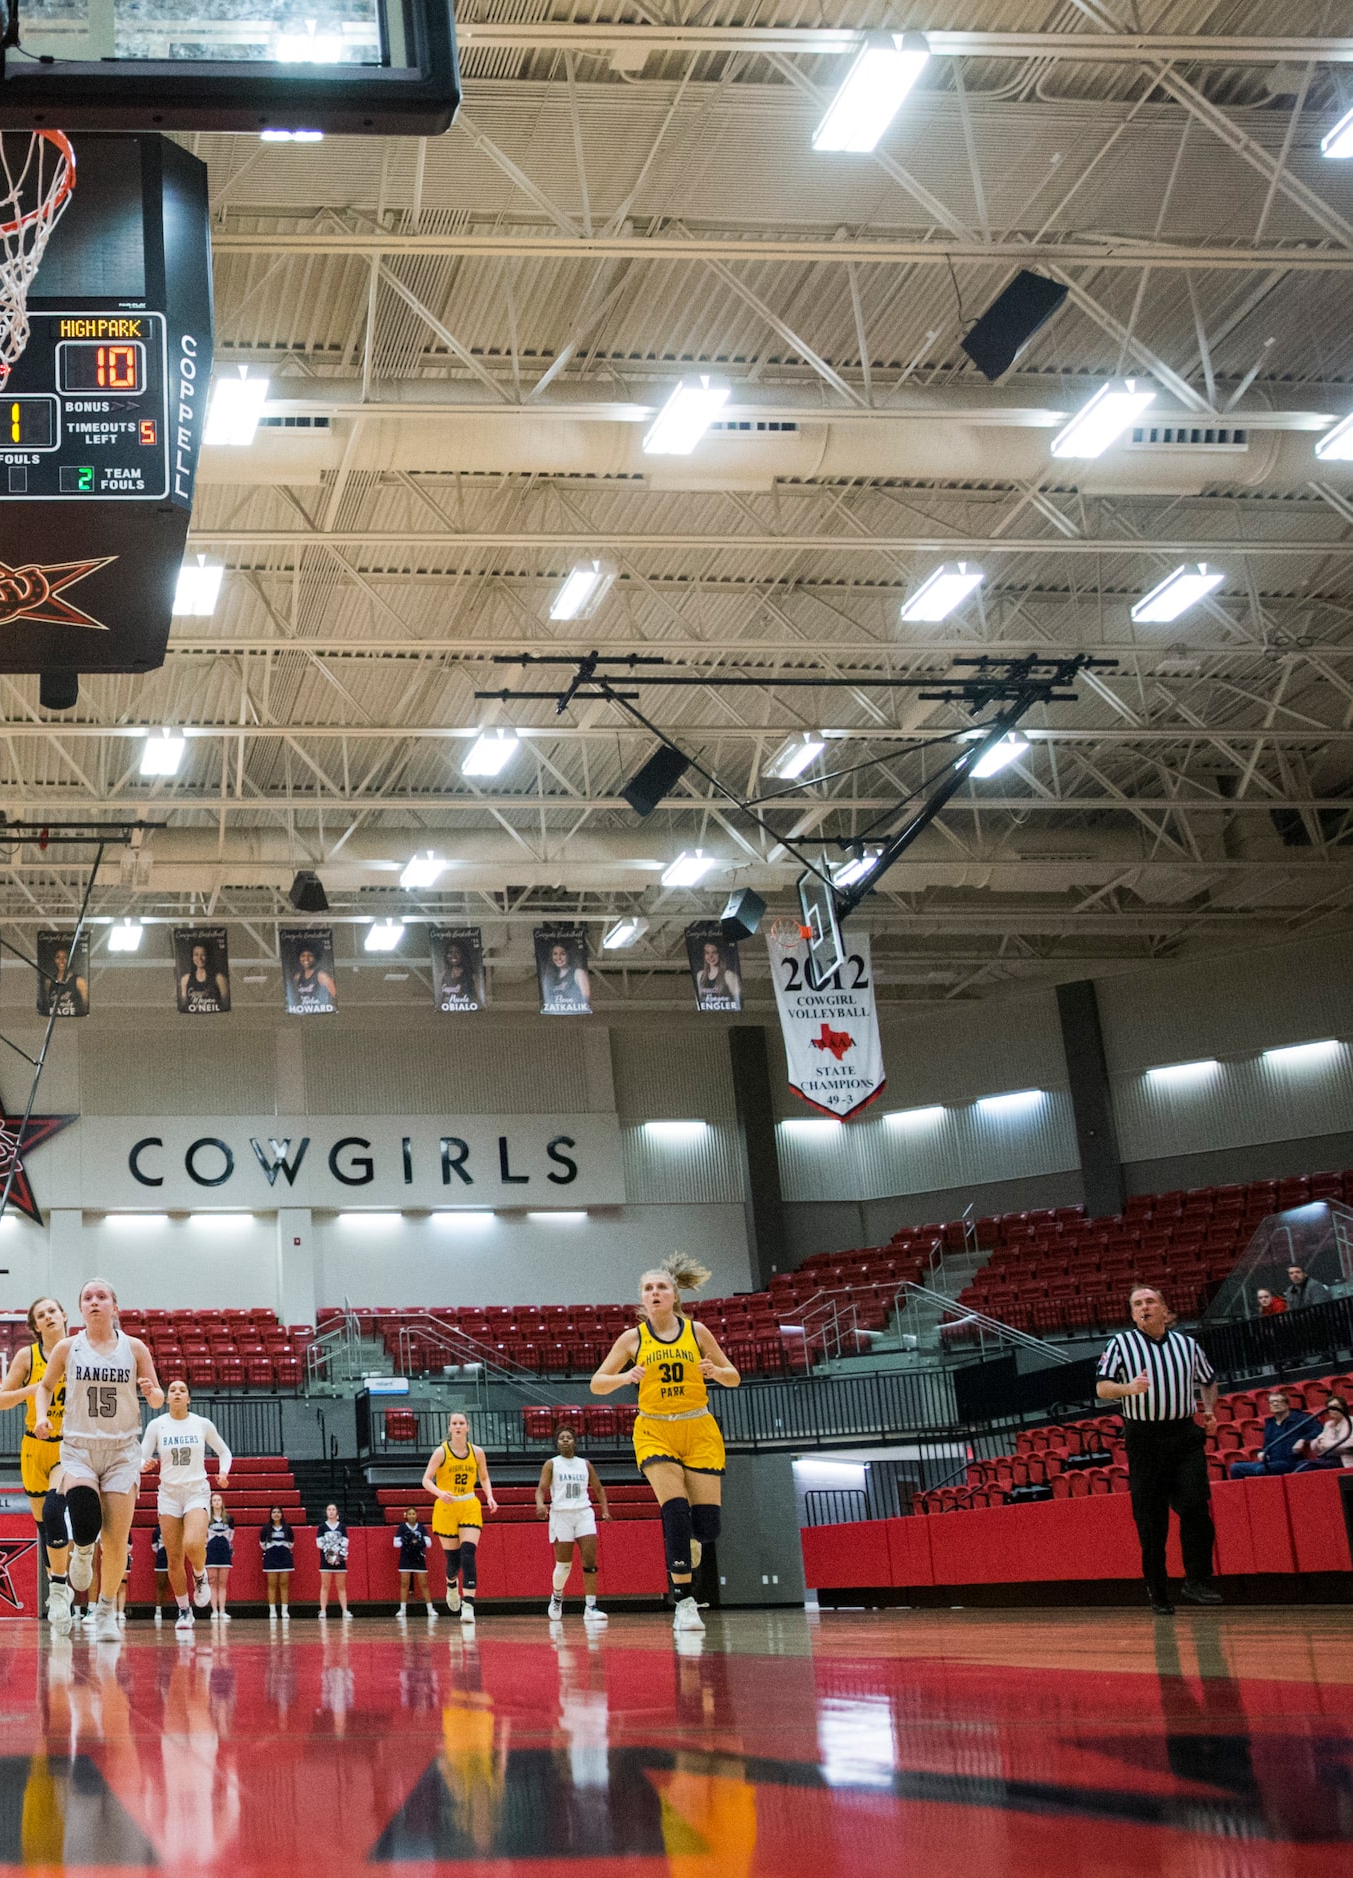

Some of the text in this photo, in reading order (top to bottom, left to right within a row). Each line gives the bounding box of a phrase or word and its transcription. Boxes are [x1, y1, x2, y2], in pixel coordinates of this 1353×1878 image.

[96, 346, 135, 387] 10
[65, 401, 110, 413] BONUS
[174, 334, 198, 500] COPPELL
[67, 422, 137, 433] TIMEOUTS
[140, 421, 155, 443] 5
[85, 434, 118, 445] LEFT
[78, 467, 92, 490] 2
[104, 468, 142, 479] TEAM
[100, 479, 145, 490] FOULS
[700, 1001, 738, 1010] ENGLER
[797, 995, 857, 1006] COWGIRL
[188, 1004, 221, 1012] O'NEIL
[288, 1004, 334, 1014] HOWARD
[441, 1003, 478, 1012] OBIALO
[543, 1002, 588, 1012] ZATKALIK
[788, 1007, 871, 1020] VOLLEYBALL
[815, 1065, 857, 1077] STATE
[800, 1078, 875, 1090] CHAMPIONS
[128, 1136, 579, 1188] COWGIRLS
[646, 1347, 695, 1366] HIGHLAND
[75, 1365, 131, 1384] RANGERS
[658, 1361, 684, 1383] 30
[660, 1385, 686, 1399] PARK
[86, 1386, 118, 1418] 15
[162, 1435, 199, 1447] RANGERS
[170, 1446, 192, 1466] 12
[448, 1464, 475, 1475] HIGHLAND
[454, 1473, 468, 1486] 22
[565, 1483, 581, 1499] 10
